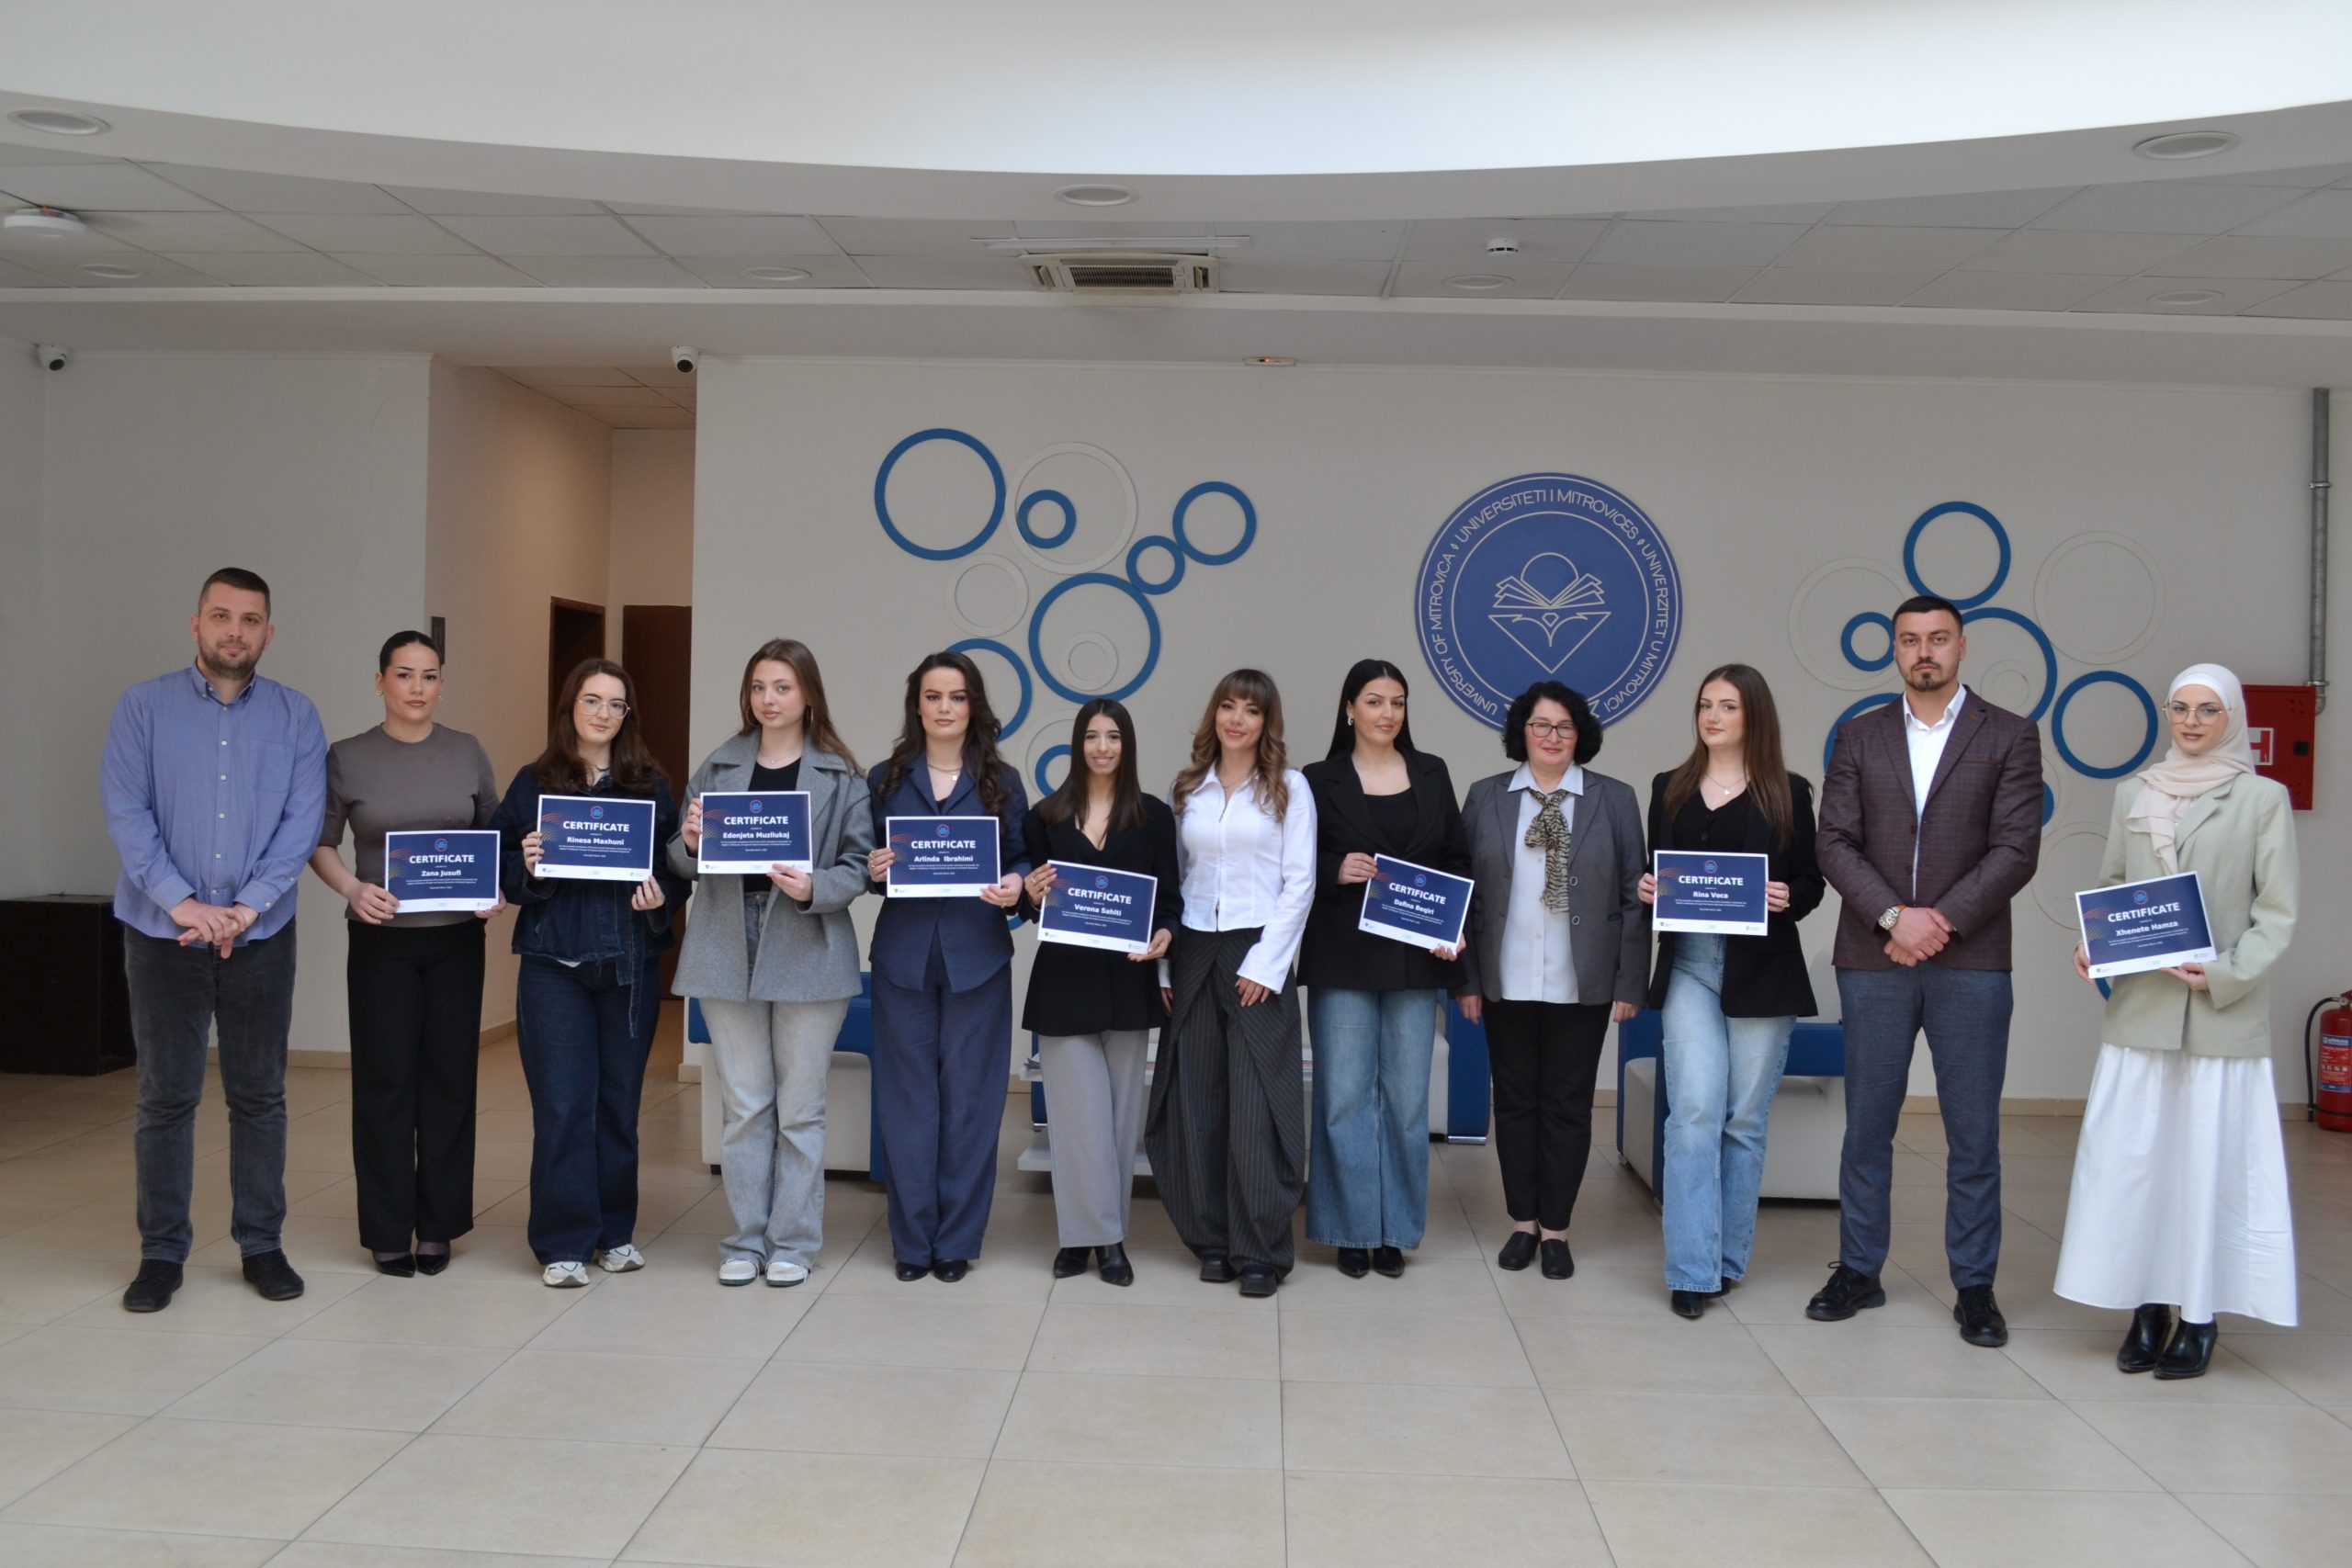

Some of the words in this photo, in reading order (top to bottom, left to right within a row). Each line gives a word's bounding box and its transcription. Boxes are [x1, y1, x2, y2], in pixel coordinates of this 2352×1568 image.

[1454, 490, 1546, 543] UNIVERSITETI
[1550, 489, 1554, 502] I
[1557, 489, 1639, 540] MITROVICES
[1429, 554, 1456, 630] MITROVICA
[1641, 544, 1669, 638] UNIVERZITET
[1432, 634, 1448, 654] OF
[1651, 640, 1664, 651] U
[1441, 657, 1498, 716] UNIVERSITY
[1603, 652, 1658, 713] MITROVICI
[563, 820, 630, 832] CERTIFICATE
[724, 816, 788, 825] CERTIFICATE
[910, 840, 977, 849] CERTIFICATE
[409, 854, 475, 863] CERTIFICATE
[1678, 875, 1744, 886] CERTIFICATE
[1068, 887, 1132, 905] CERTIFICATE
[1389, 882, 1446, 905] CERTIFICATE
[1074, 904, 1099, 913] Verona
[2108, 902, 2181, 922] CERTIFICATE
[2151, 920, 2178, 931] Hamza
